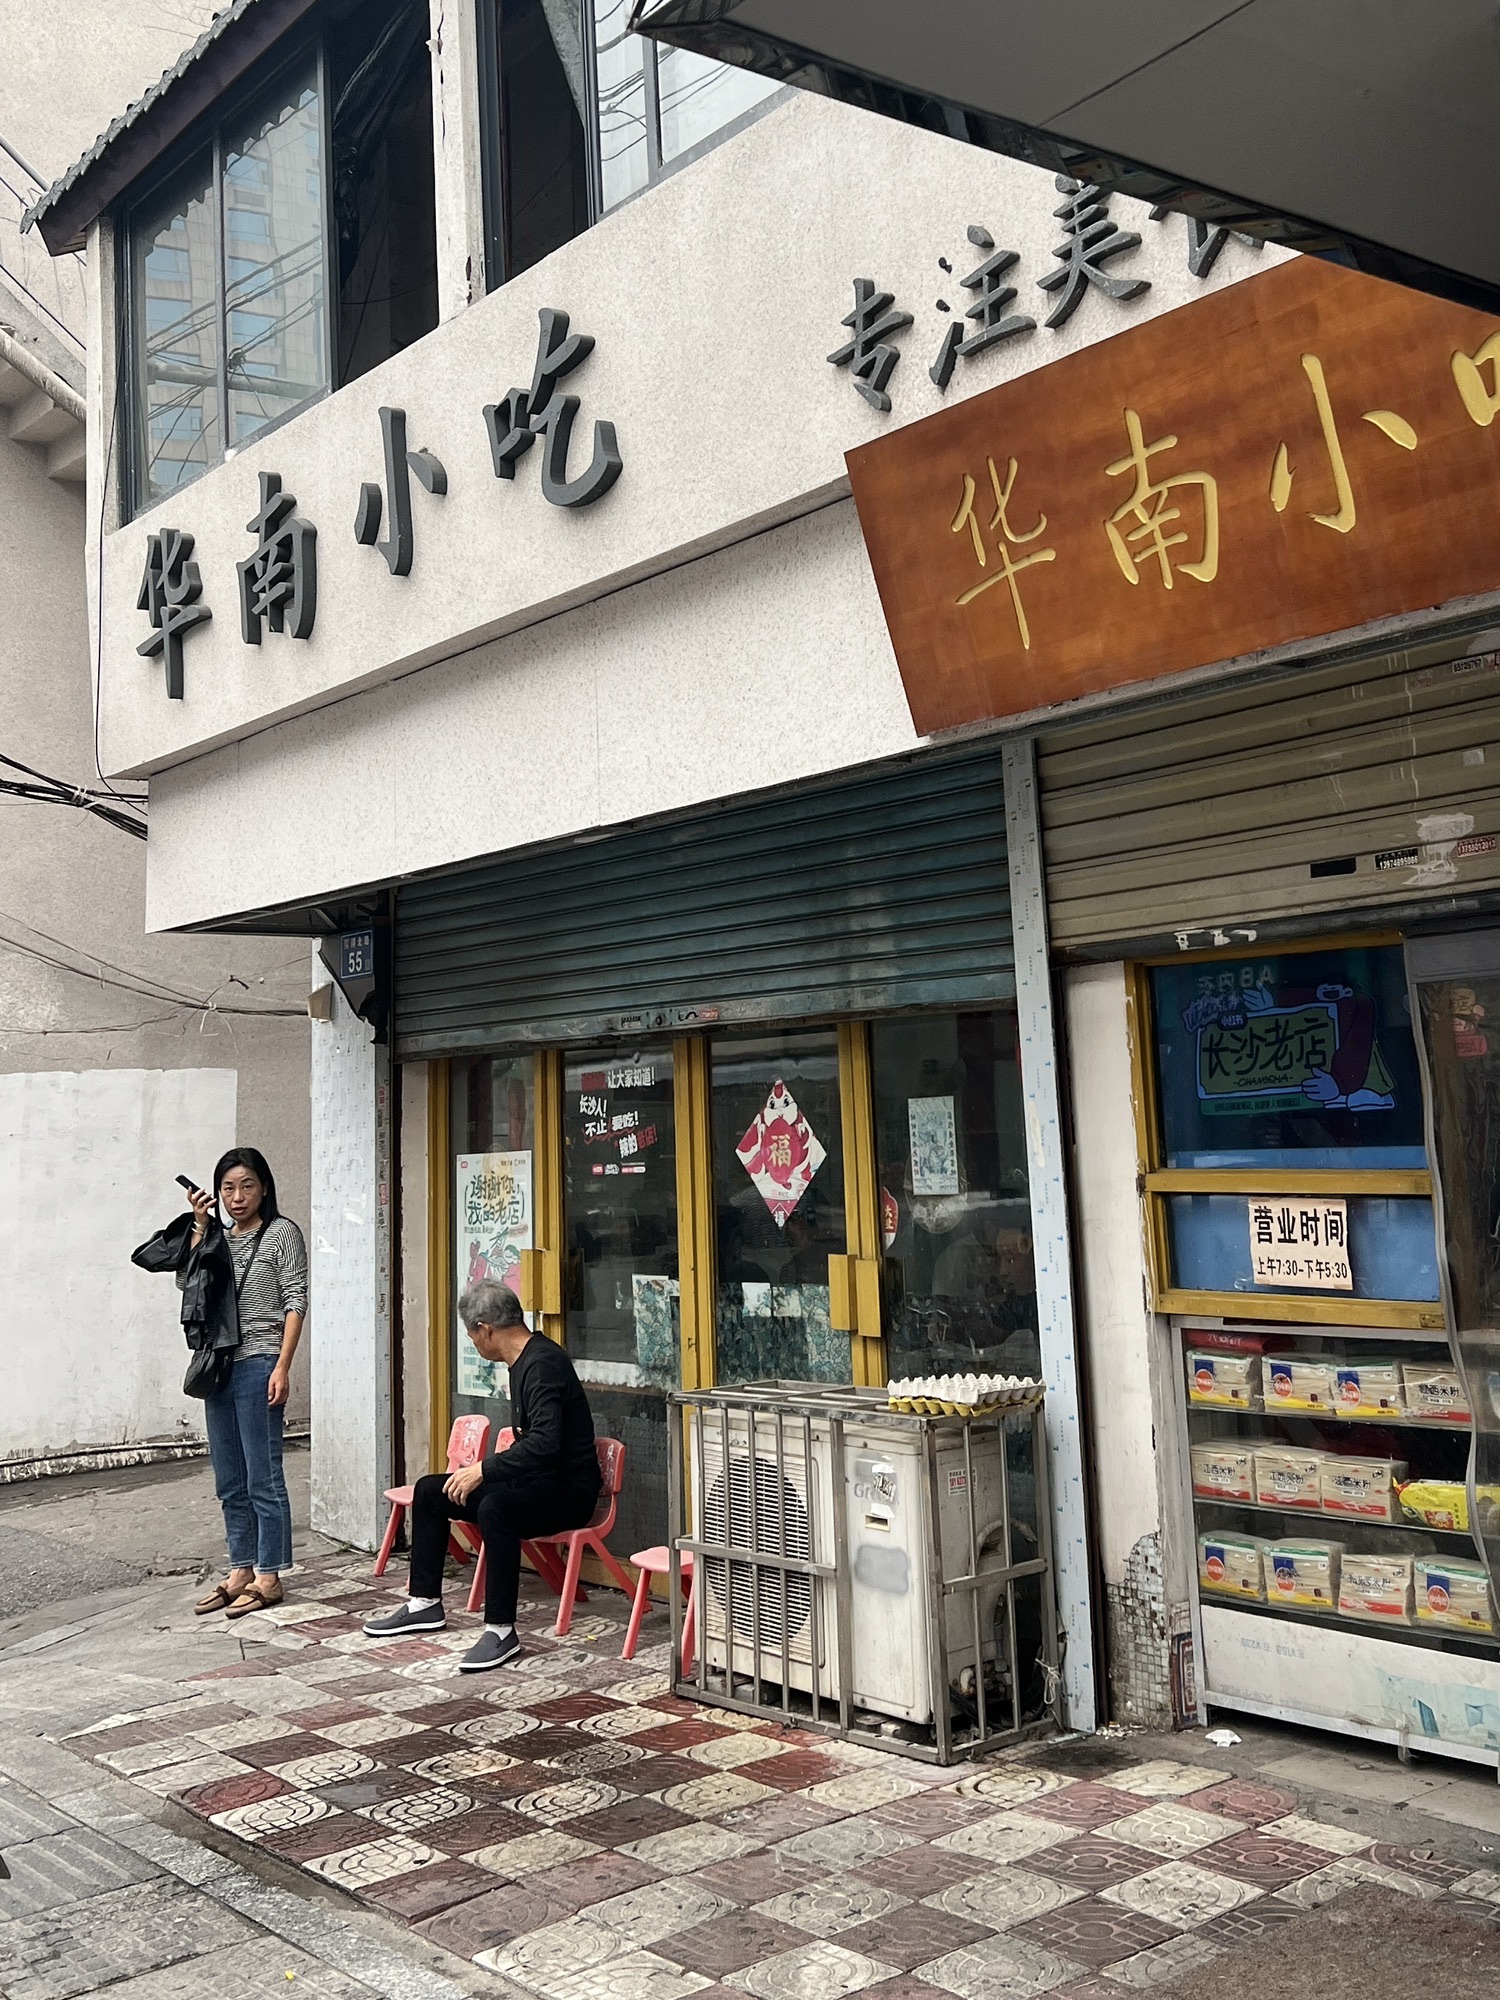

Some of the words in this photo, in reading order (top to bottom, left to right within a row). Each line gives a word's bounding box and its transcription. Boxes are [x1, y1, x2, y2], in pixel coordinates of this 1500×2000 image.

[827, 174, 1265, 412] 专注美
[136, 308, 623, 699] 华南小吃
[348, 950, 362, 973] 55
[1202, 1017, 1329, 1079] 长沙老店
[607, 1066, 655, 1089] 让大家知道!
[579, 1094, 607, 1118] 长沙人!
[585, 1119, 608, 1137] 不止
[611, 1110, 639, 1131] 爱吃!
[767, 1133, 792, 1168] 福
[467, 1195, 520, 1225] 我的老店
[1254, 1206, 1344, 1247] 营业时间
[1257, 1256, 1348, 1280] 上午7:30-下午5:30
